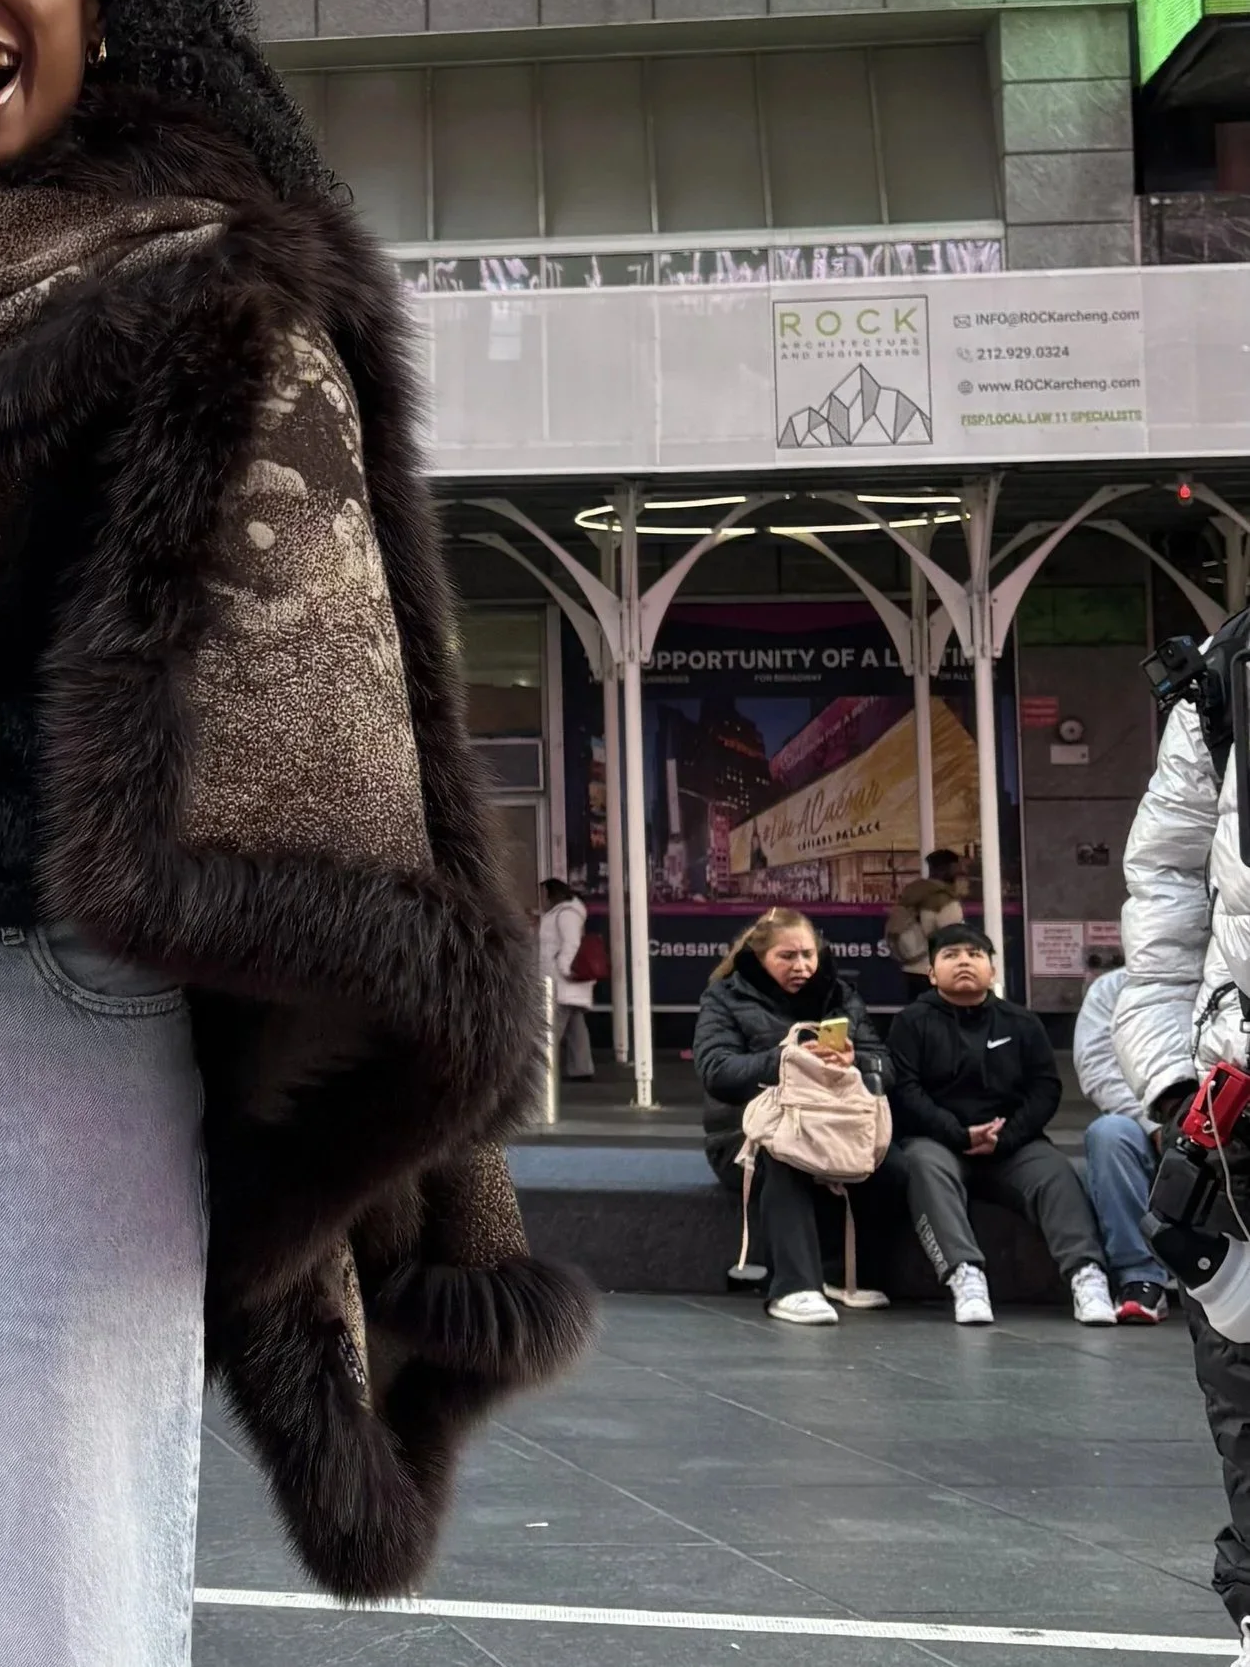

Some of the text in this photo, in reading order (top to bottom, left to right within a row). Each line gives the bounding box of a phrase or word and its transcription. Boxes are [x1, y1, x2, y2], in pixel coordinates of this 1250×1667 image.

[779, 306, 918, 338] ROCK
[975, 309, 1140, 327] INFO@ROCKarcheng.com
[780, 336, 920, 350] ARCHITECTURE
[976, 346, 1070, 362] 212.929.0324
[978, 377, 1141, 394] www.ROCKarcheng.com
[1071, 409, 1142, 423] SPECIALISTS
[822, 648, 855, 669] OF
[861, 648, 879, 668] A
[648, 938, 729, 957] Caesars
